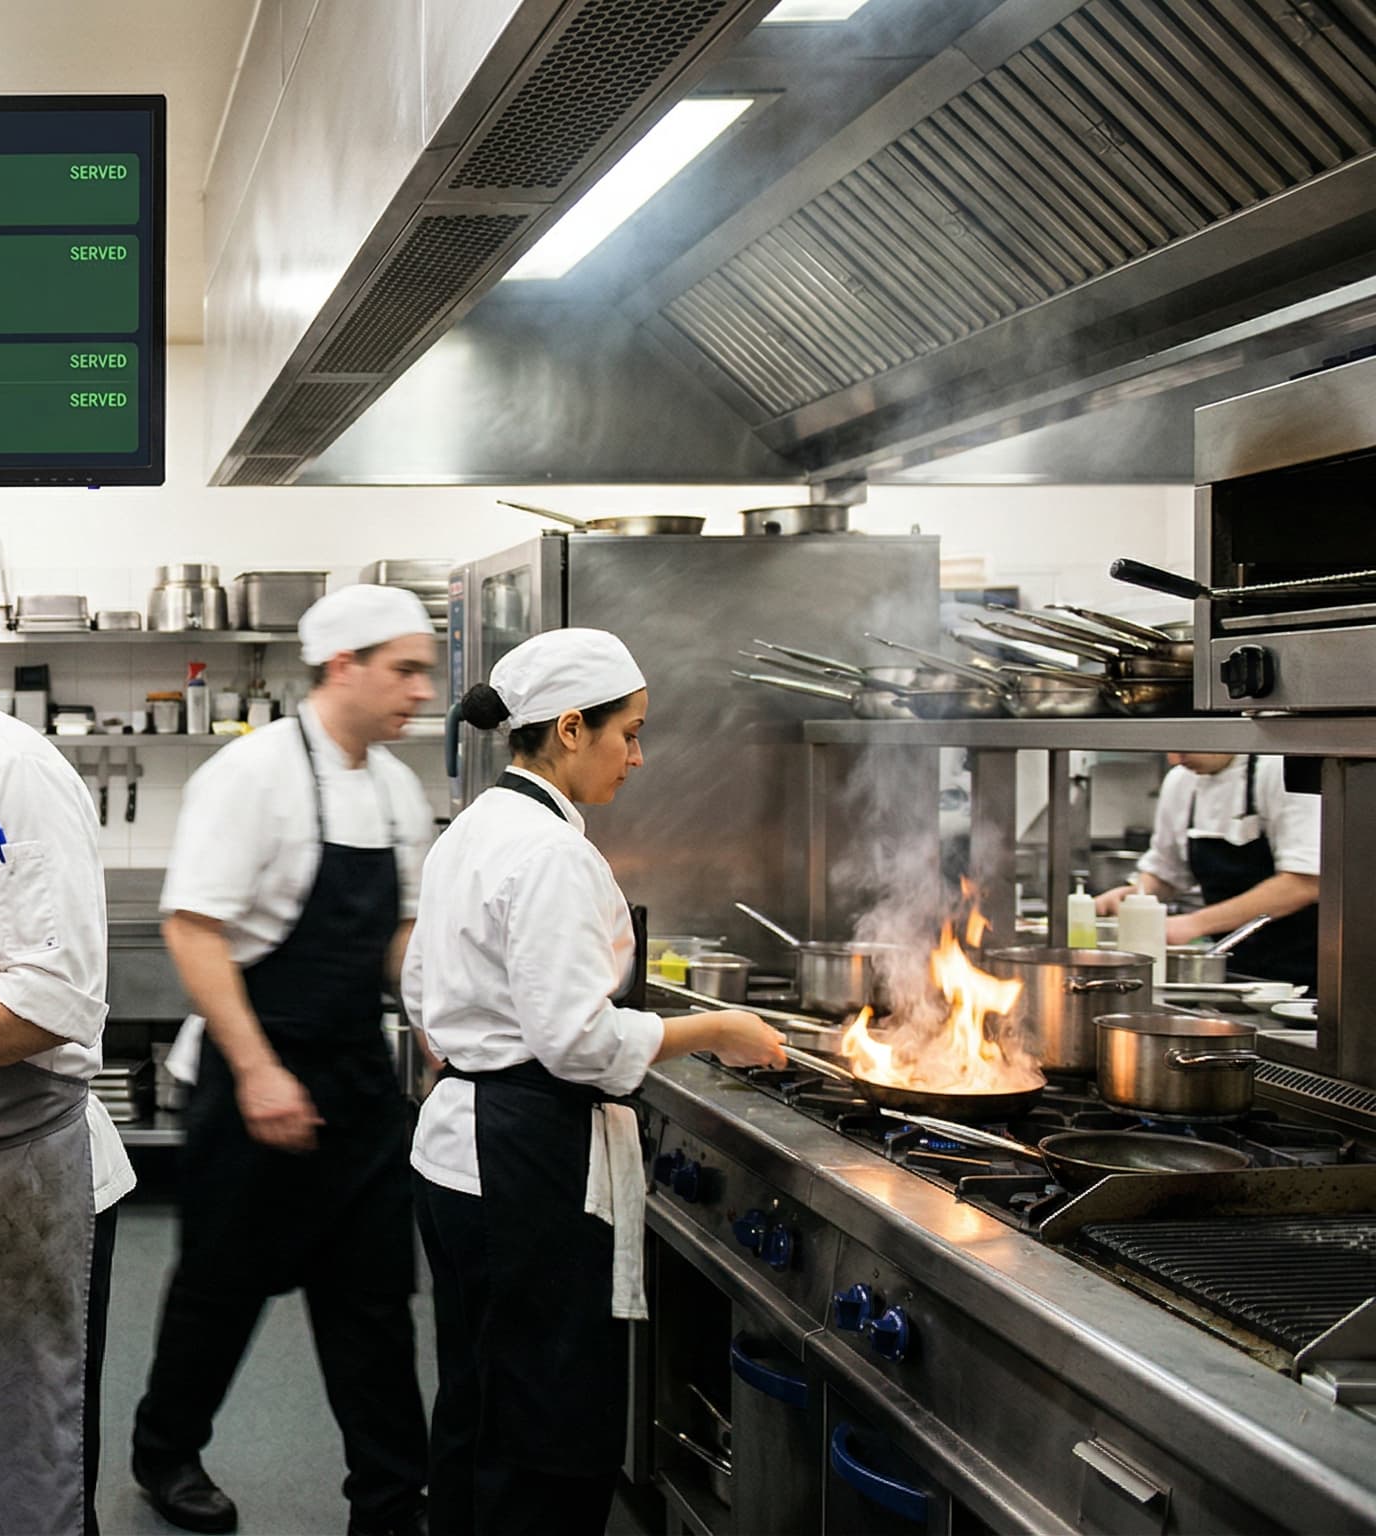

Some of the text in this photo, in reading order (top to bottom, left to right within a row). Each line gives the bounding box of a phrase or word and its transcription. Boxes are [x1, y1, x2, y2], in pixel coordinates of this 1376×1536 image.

[70, 165, 126, 179] SERVED
[71, 246, 126, 260] SERVED
[70, 354, 126, 368] SERVED
[70, 393, 126, 407] SERVED
